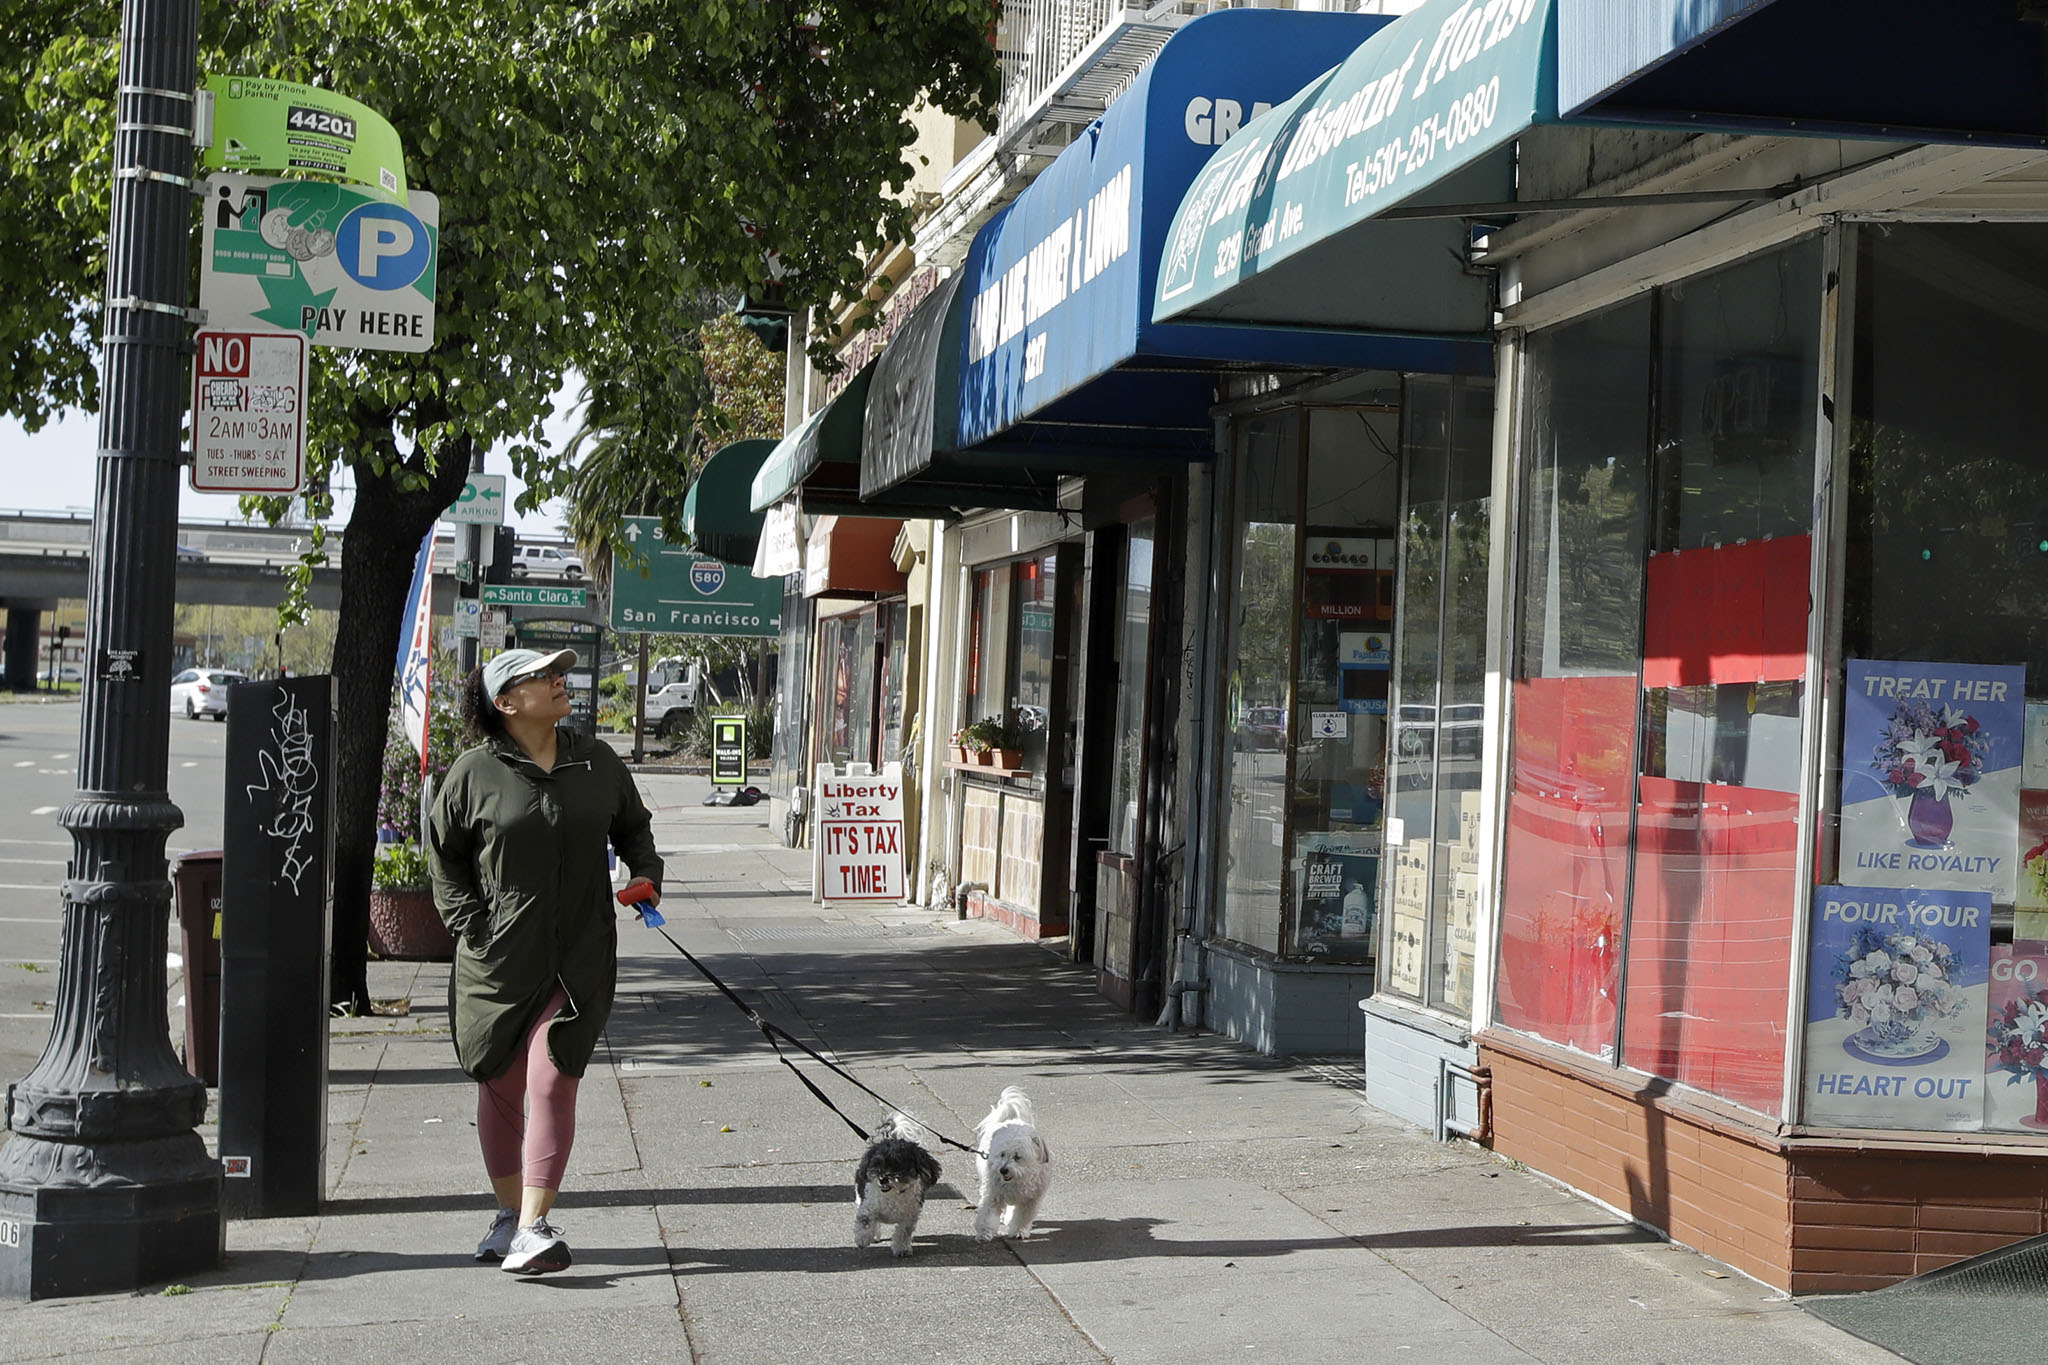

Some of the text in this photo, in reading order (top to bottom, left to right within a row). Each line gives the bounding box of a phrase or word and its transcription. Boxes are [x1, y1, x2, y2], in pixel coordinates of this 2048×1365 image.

[245, 90, 279, 101] Parking
[246, 81, 307, 95] Pay by Phone
[1276, 38, 1423, 182] Discount
[289, 111, 354, 138] 44201
[1344, 75, 1499, 207] Tel:510-251-0880
[358, 217, 414, 277] P
[1214, 200, 1304, 279] 3219 Grand Ave.
[301, 306, 424, 338] PAY HERE
[203, 337, 245, 373] NO
[209, 416, 292, 439] 2AM TO 3AM
[207, 448, 225, 459] TUES
[265, 451, 286, 461] SAT
[208, 466, 286, 478] STREET SWEEPING
[694, 572, 721, 583] 580
[498, 589, 569, 603] Santa Clara
[623, 609, 760, 626] San Francisco
[1321, 605, 1361, 615] MILLION
[1864, 676, 2008, 702] TREAT HER
[823, 783, 899, 801] Liberty
[842, 802, 881, 816] Tax
[827, 826, 898, 855] IT'S TAX
[1310, 864, 1343, 875] CRAFT
[1857, 851, 2000, 874] LIKE ROYALTY
[840, 865, 887, 893] TIME!
[1308, 875, 1342, 884] BREWED
[1823, 901, 1980, 928] POUR YOUR
[1991, 959, 2038, 982] GO
[1817, 1073, 1972, 1099] HEART OUT
